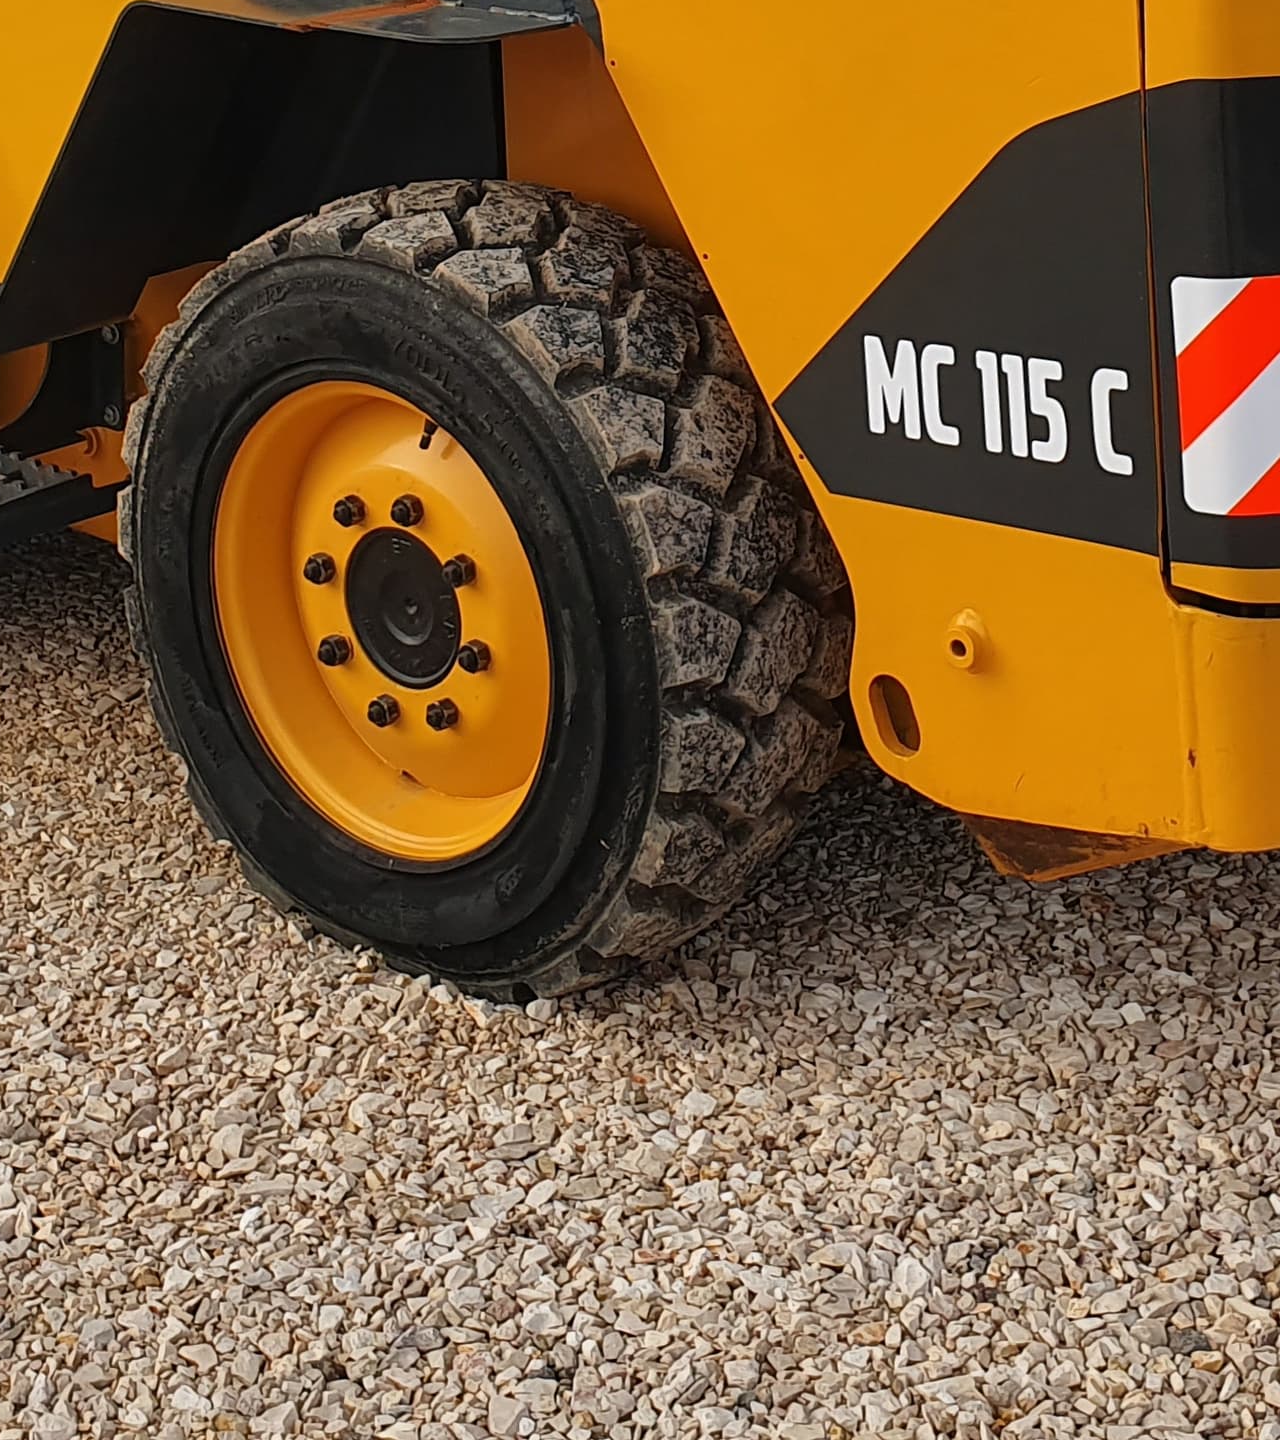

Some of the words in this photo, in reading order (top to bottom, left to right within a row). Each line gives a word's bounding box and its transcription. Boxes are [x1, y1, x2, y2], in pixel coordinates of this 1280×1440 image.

[863, 335, 960, 446] MC
[975, 350, 1068, 463] 115
[1091, 368, 1133, 476] C
